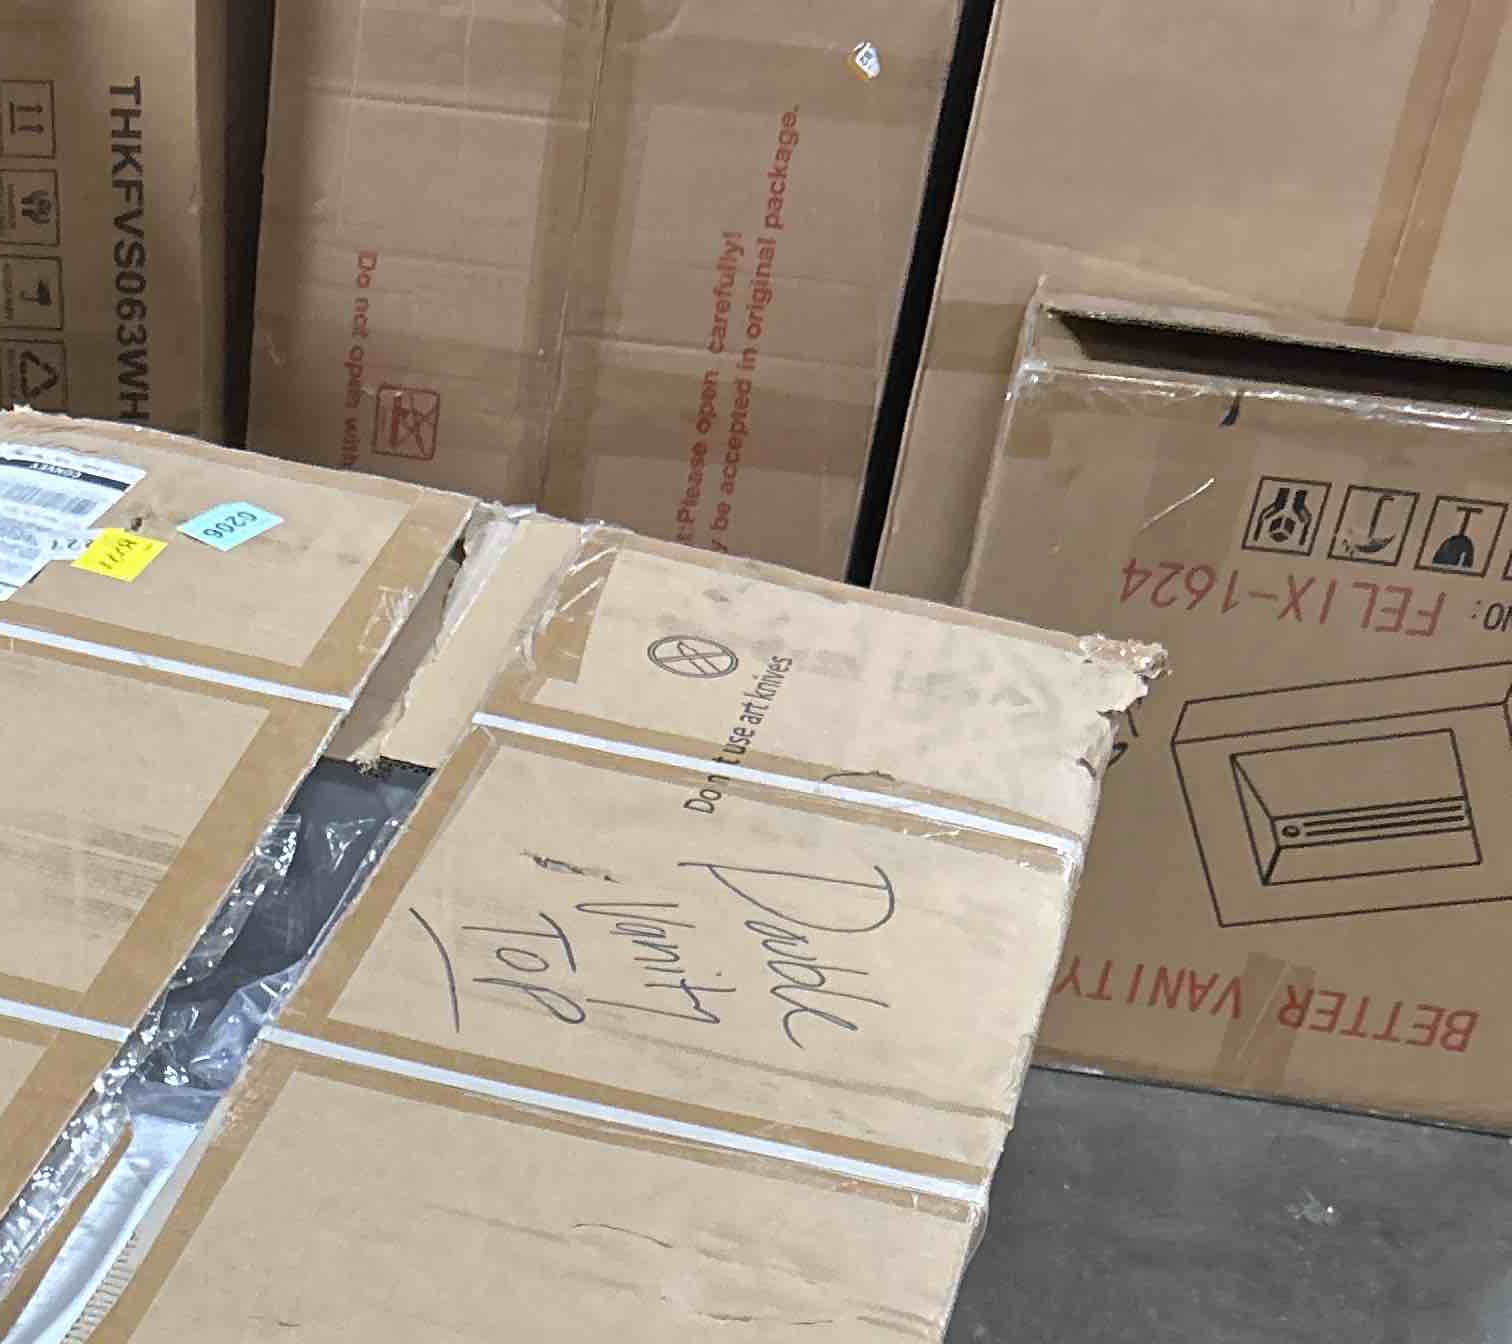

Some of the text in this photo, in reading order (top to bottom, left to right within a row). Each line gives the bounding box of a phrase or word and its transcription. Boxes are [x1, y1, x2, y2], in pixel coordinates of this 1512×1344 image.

[109, 75, 151, 422] THKFVS063WH
[357, 249, 378, 289] Do
[745, 236, 777, 340] original
[351, 297, 370, 339] not
[695, 367, 720, 435] open
[708, 231, 745, 354] carefully!
[736, 347, 759, 370] in
[343, 345, 366, 409] open
[719, 377, 754, 496] accepted
[710, 501, 733, 531] be
[682, 655, 794, 815] Do nt use art knives
[1054, 956, 1481, 1053] BETTER VANITY
